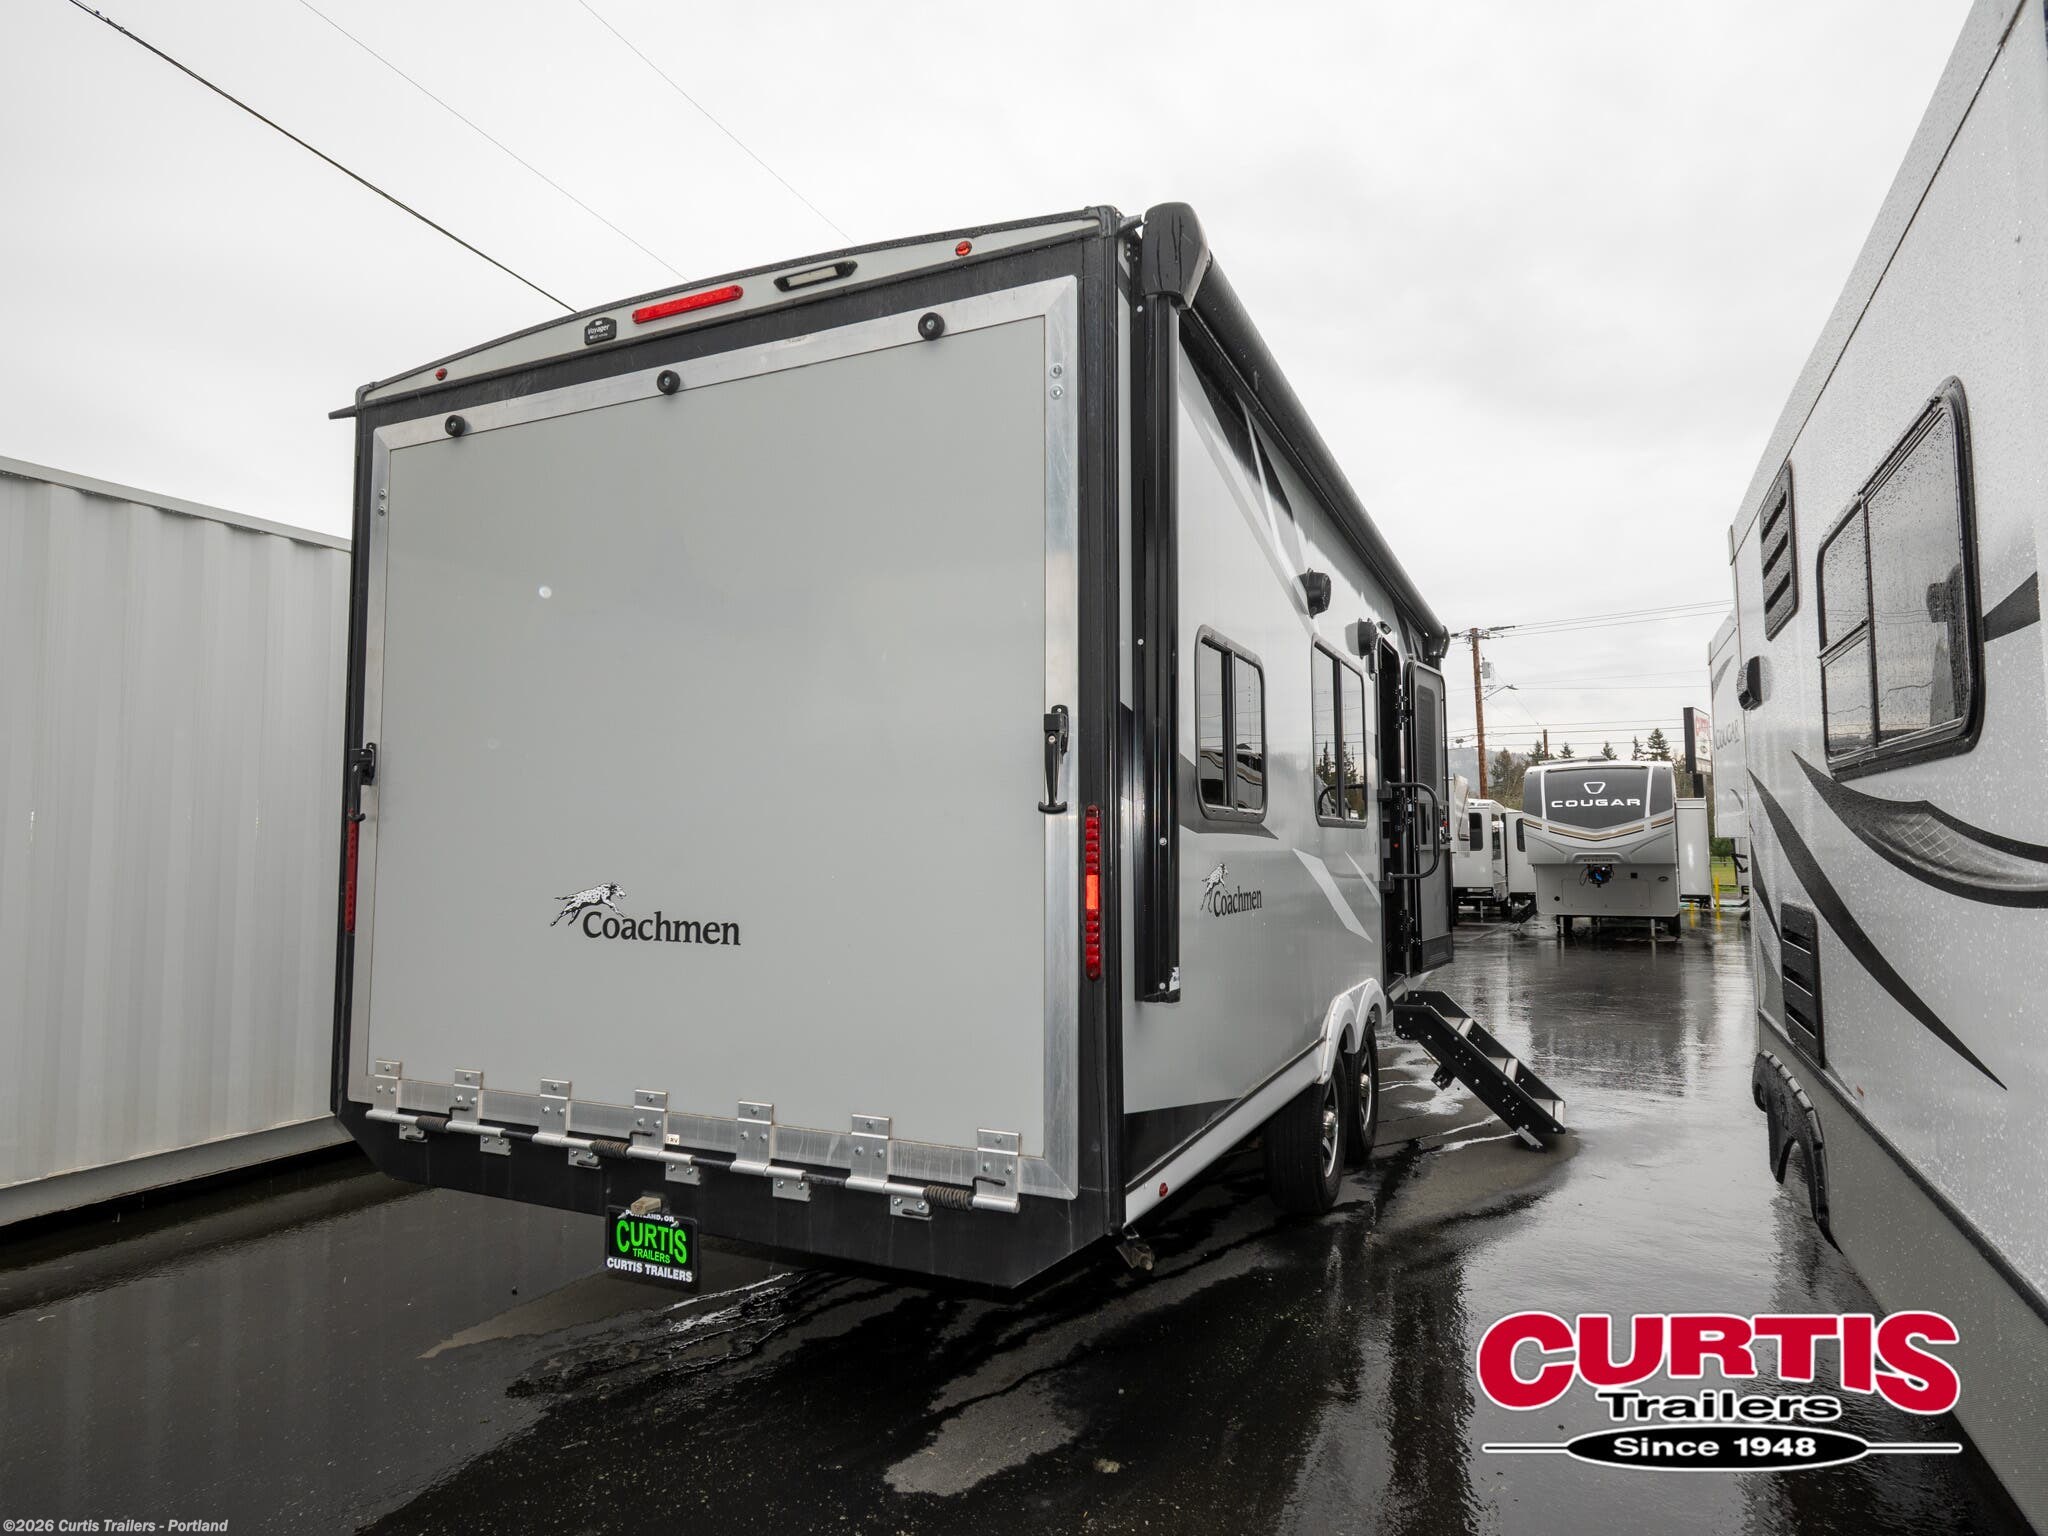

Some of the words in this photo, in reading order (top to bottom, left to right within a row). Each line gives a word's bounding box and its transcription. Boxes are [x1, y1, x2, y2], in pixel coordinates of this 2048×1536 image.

[1551, 798, 1641, 808] COUGAR
[1213, 885, 1262, 918] Coachmen
[582, 911, 742, 946] Coachmen
[616, 1220, 687, 1264] CURTIS
[632, 1248, 671, 1264] TRAILERS
[606, 1257, 643, 1273] CURTIS
[644, 1263, 693, 1283] TRAILERS
